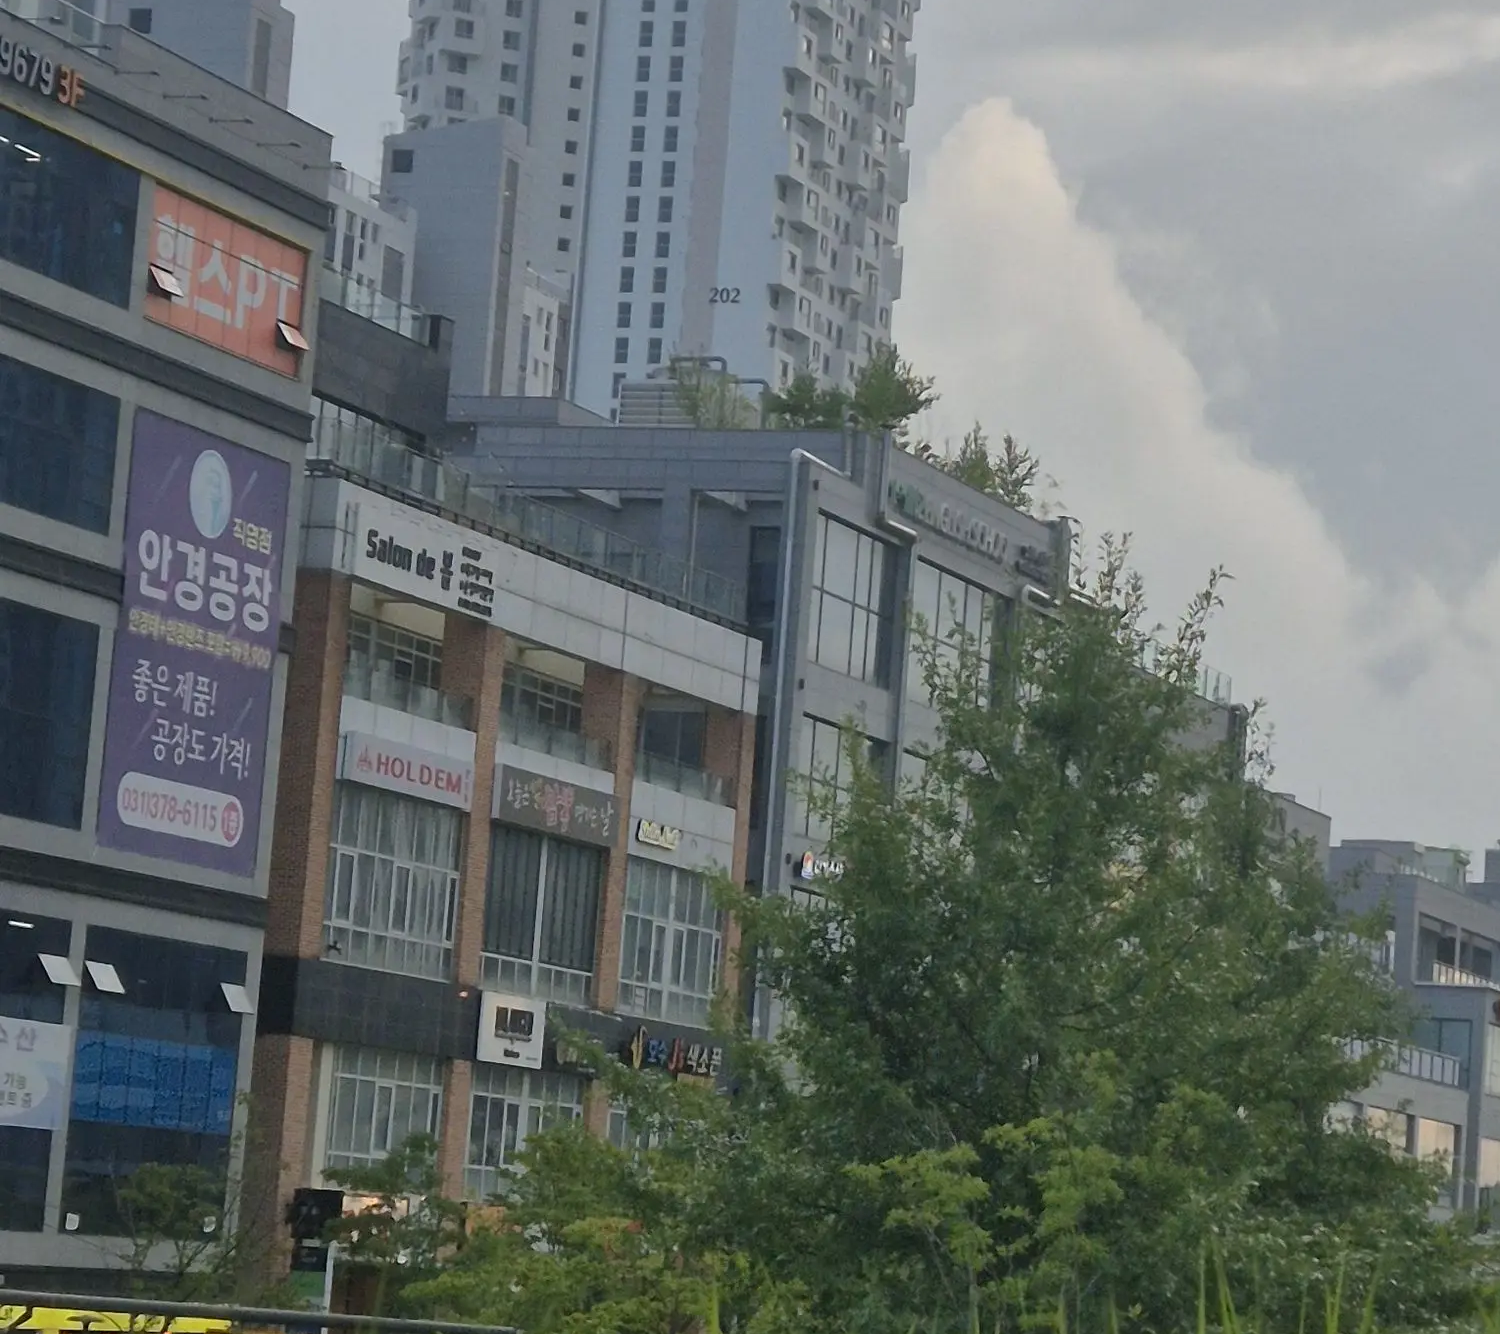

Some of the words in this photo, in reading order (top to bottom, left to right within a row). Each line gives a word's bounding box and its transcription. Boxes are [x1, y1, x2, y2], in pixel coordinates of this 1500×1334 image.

[57, 65, 85, 106] 3F
[709, 287, 741, 304] 202
[233, 517, 272, 555] 직영점
[366, 528, 413, 573] Salon
[416, 548, 436, 581] de
[138, 529, 272, 633] 안경공장
[132, 658, 171, 707] 좋은
[173, 671, 218, 717] 제품!
[151, 718, 206, 765] 공장도
[210, 733, 251, 781] 가격!
[376, 752, 462, 796] HOLDEM
[121, 787, 218, 833] 031)378-6115
